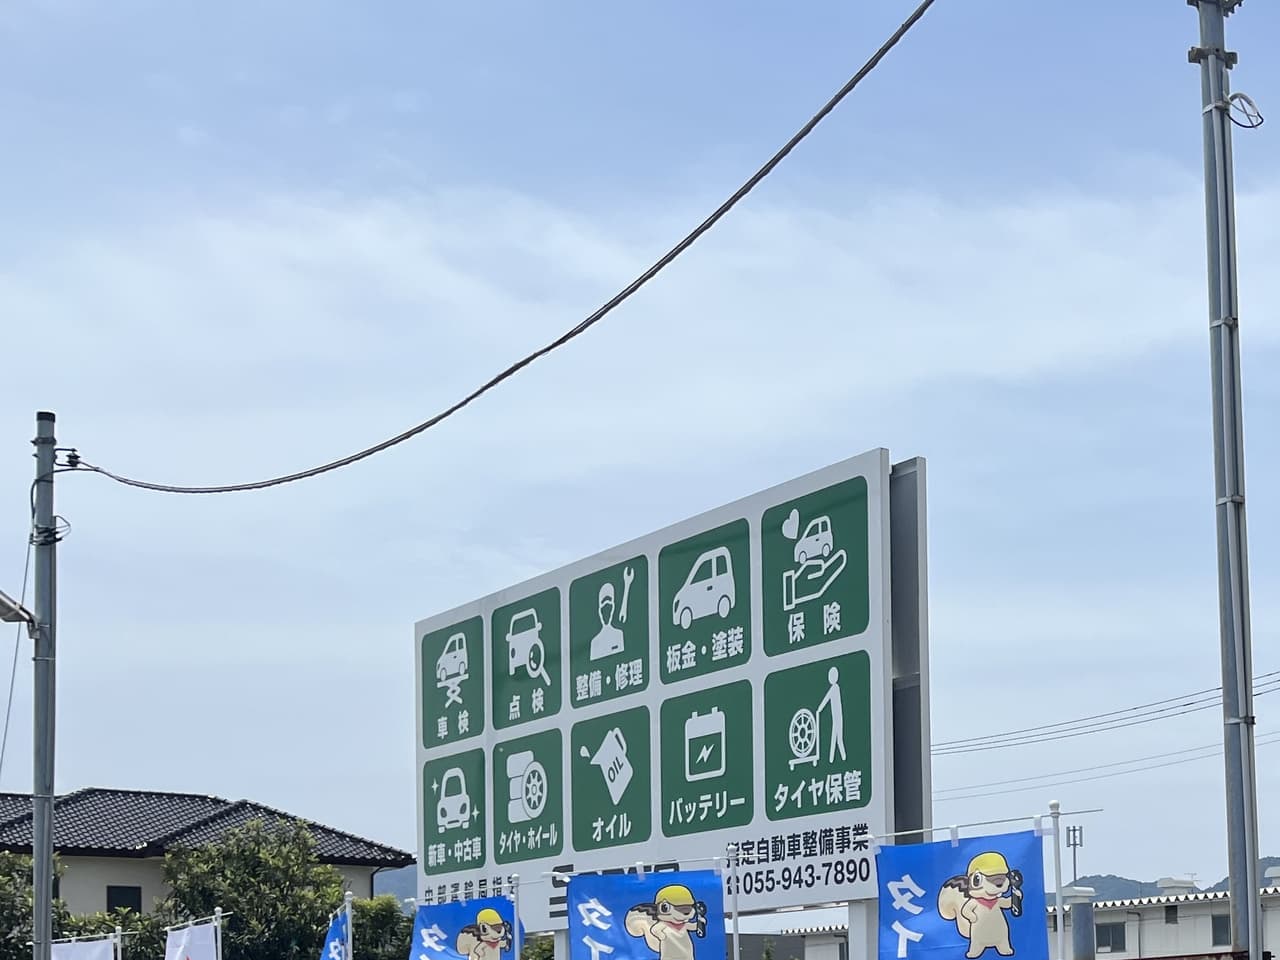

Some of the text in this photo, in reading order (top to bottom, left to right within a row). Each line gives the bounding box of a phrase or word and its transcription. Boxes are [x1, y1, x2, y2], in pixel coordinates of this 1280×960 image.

[787, 601, 841, 644] 保険
[666, 626, 744, 673] 板金・塗装
[575, 658, 643, 701] 整備・修理
[509, 687, 544, 720] 点検
[437, 710, 469, 739] 車検
[607, 757, 624, 783] OIL
[774, 769, 862, 812] タイヤ保管
[669, 791, 745, 825] バッテリー
[500, 823, 557, 854] タイヤ・ホイール
[592, 813, 632, 842] オイル
[428, 837, 481, 867] 新車・中古車
[743, 858, 870, 895] 055-943-7890
